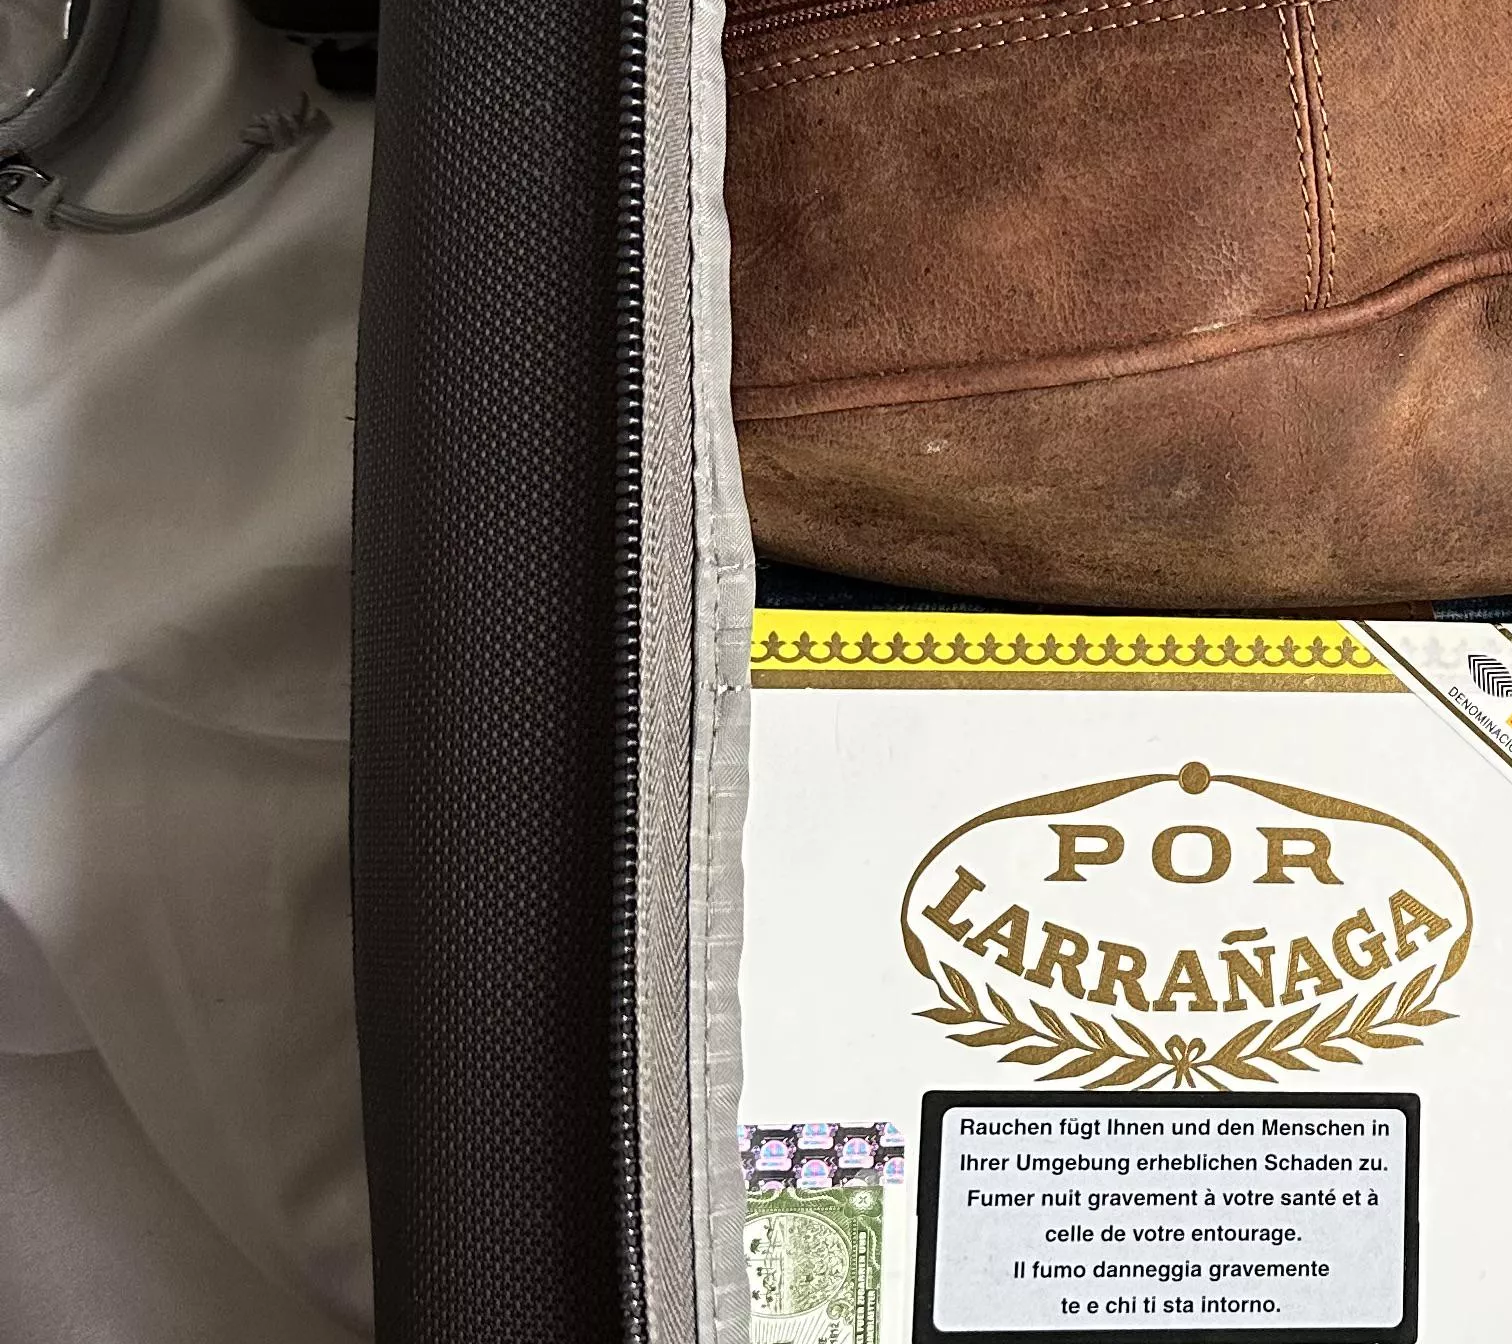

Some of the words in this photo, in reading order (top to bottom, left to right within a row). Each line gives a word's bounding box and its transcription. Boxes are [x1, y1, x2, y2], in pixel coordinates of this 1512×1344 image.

[1044, 824, 1344, 885] POR
[922, 865, 1452, 1012] LARRAÑAGA
[960, 1118, 1052, 1136] Rauchen
[1059, 1117, 1101, 1140] fügt
[1107, 1118, 1164, 1136] Ihnen
[1172, 1118, 1211, 1136] und
[1217, 1118, 1255, 1136] den
[1262, 1118, 1365, 1136] Menschen
[1372, 1119, 1390, 1137] in
[960, 1153, 1010, 1171] Ihrer
[1016, 1153, 1130, 1176] Umgebung
[1136, 1153, 1257, 1171] erheblichen
[1264, 1153, 1353, 1171] Schaden
[1358, 1158, 1388, 1171] zu.
[967, 1189, 1036, 1207] Fumer
[1041, 1188, 1082, 1207] nuit
[1088, 1189, 1198, 1211] gravement
[1204, 1188, 1216, 1206] à
[1222, 1189, 1274, 1206] votre
[1280, 1188, 1337, 1206] santé
[1342, 1189, 1362, 1206] et
[1367, 1188, 1379, 1206] à
[1045, 1224, 1094, 1243] celle
[1100, 1224, 1126, 1242] de
[1132, 1225, 1185, 1242] votre
[1191, 1225, 1302, 1246] entourage.
[1014, 1261, 1025, 1279] Il
[1032, 1260, 1086, 1279] fumo
[1092, 1260, 1202, 1282] danneggia
[1209, 1260, 1330, 1282] gravemente
[1061, 1297, 1081, 1314] te
[1086, 1300, 1099, 1314] e
[1105, 1296, 1137, 1314] chi
[1143, 1295, 1156, 1314] ti
[1163, 1296, 1194, 1314] sta
[1201, 1295, 1281, 1313] intorno.
